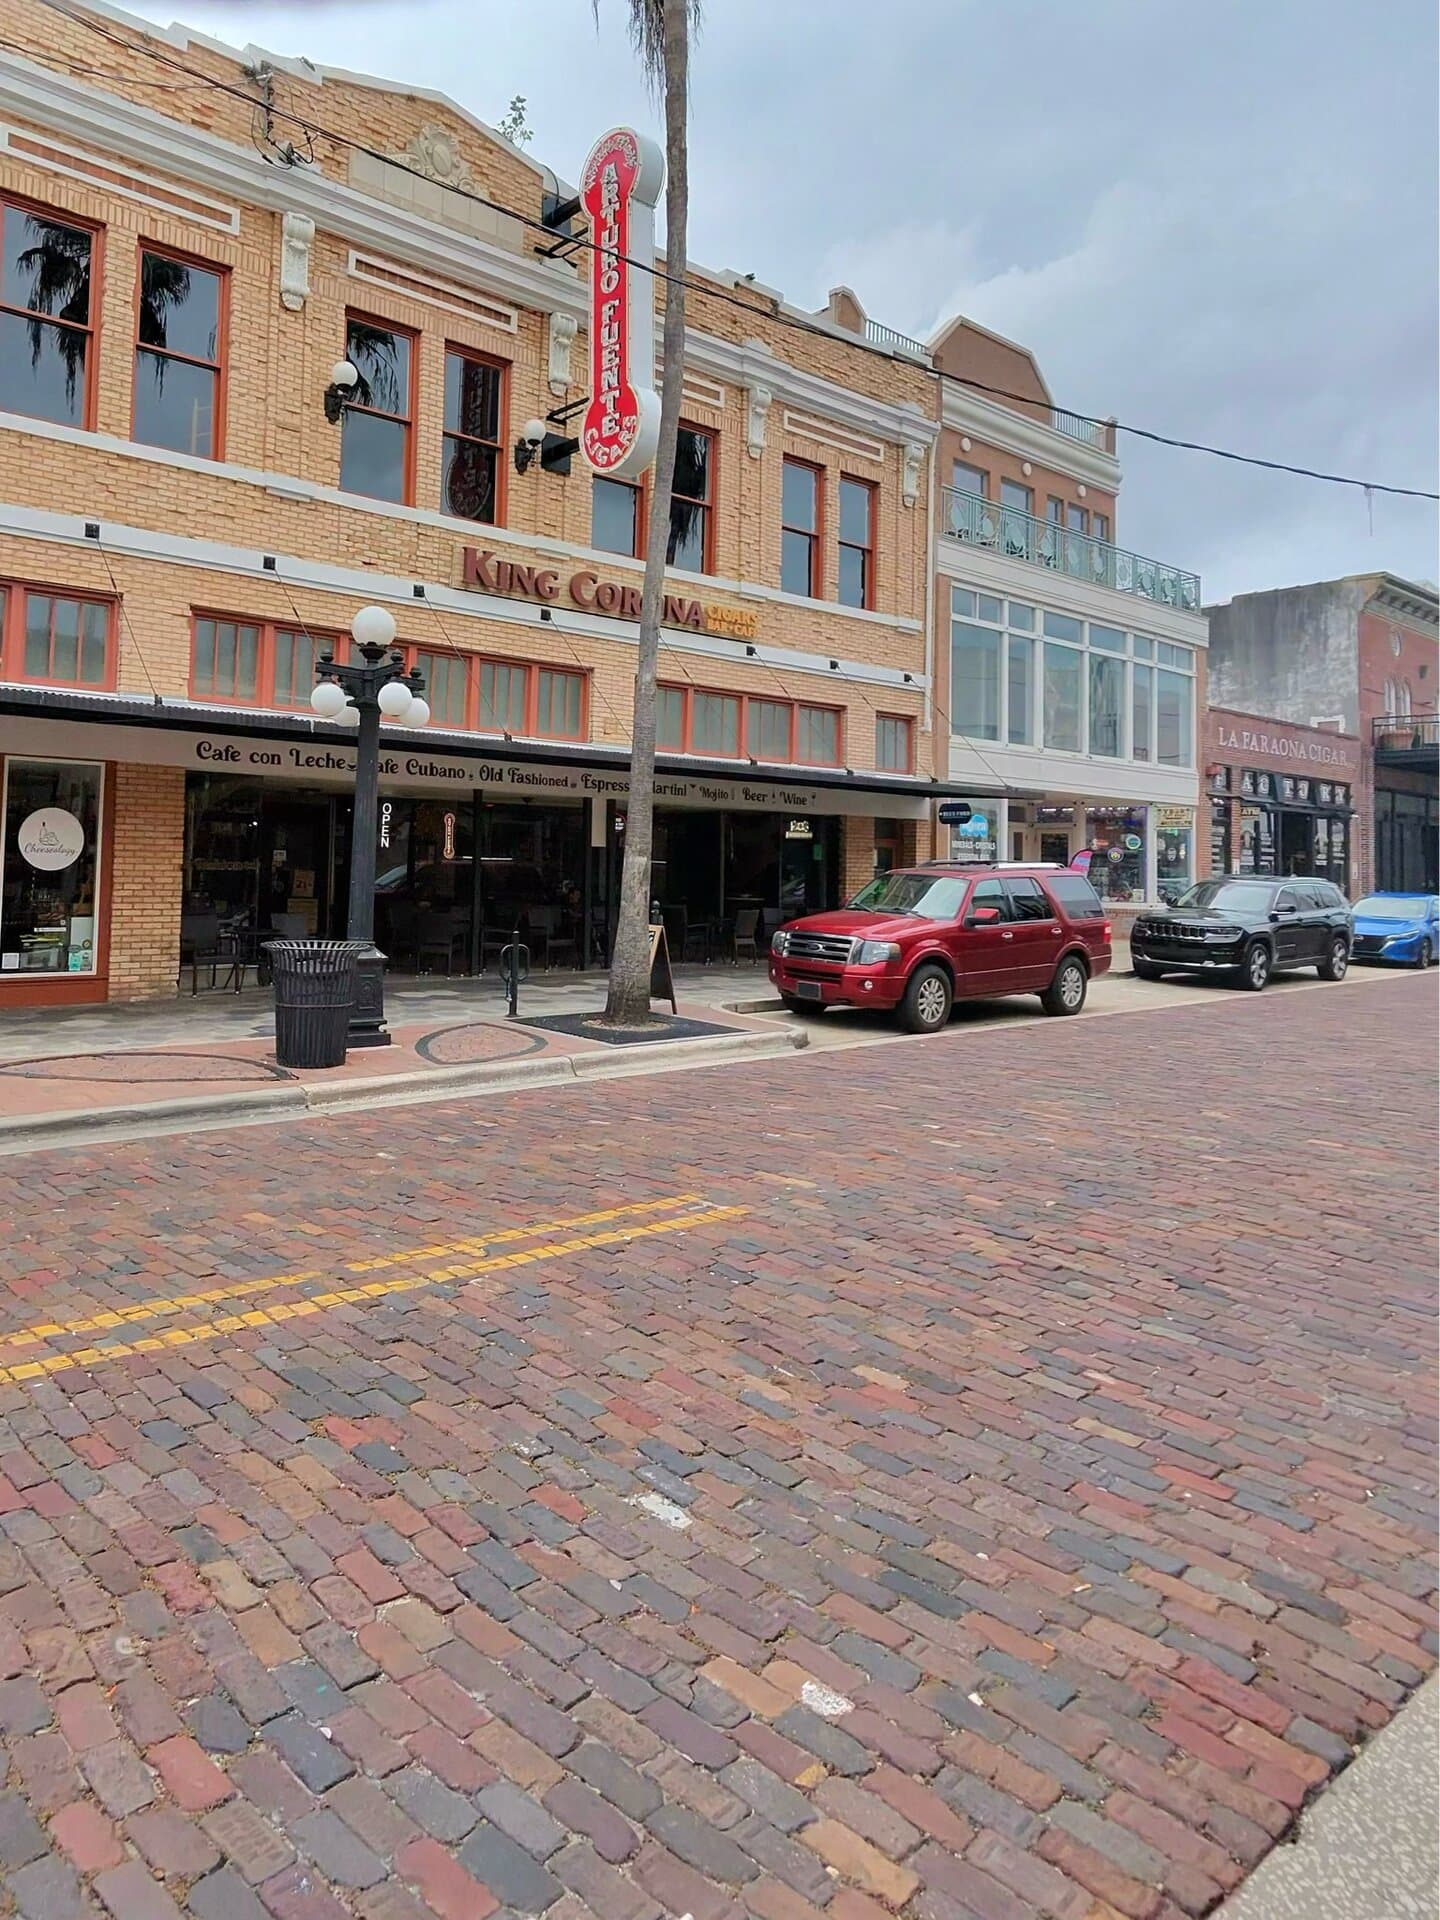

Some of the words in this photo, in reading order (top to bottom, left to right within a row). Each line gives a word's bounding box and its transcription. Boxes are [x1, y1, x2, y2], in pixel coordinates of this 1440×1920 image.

[600, 162, 620, 294] ARTURO
[600, 298, 621, 438] FUENTE
[585, 414, 636, 466] CIGARS
[463, 546, 559, 600] KING
[569, 571, 706, 627] CORNA
[707, 603, 760, 625] CIGARS
[196, 740, 241, 762] Cafe
[249, 751, 281, 765] con
[289, 748, 346, 769] Leche
[378, 759, 399, 774] afe
[405, 758, 465, 779] Cubano
[480, 764, 503, 782] Old
[508, 767, 568, 787] Fashioned
[581, 772, 630, 792] Espress
[653, 780, 687, 796] artini
[699, 785, 729, 801] Mojito
[742, 786, 768, 803] Beer
[780, 791, 808, 806] Wine
[1217, 727, 1239, 748] LA
[1242, 731, 1307, 760] FARAONA
[1308, 743, 1348, 766] CIGAR
[381, 803, 392, 848] OPEN
